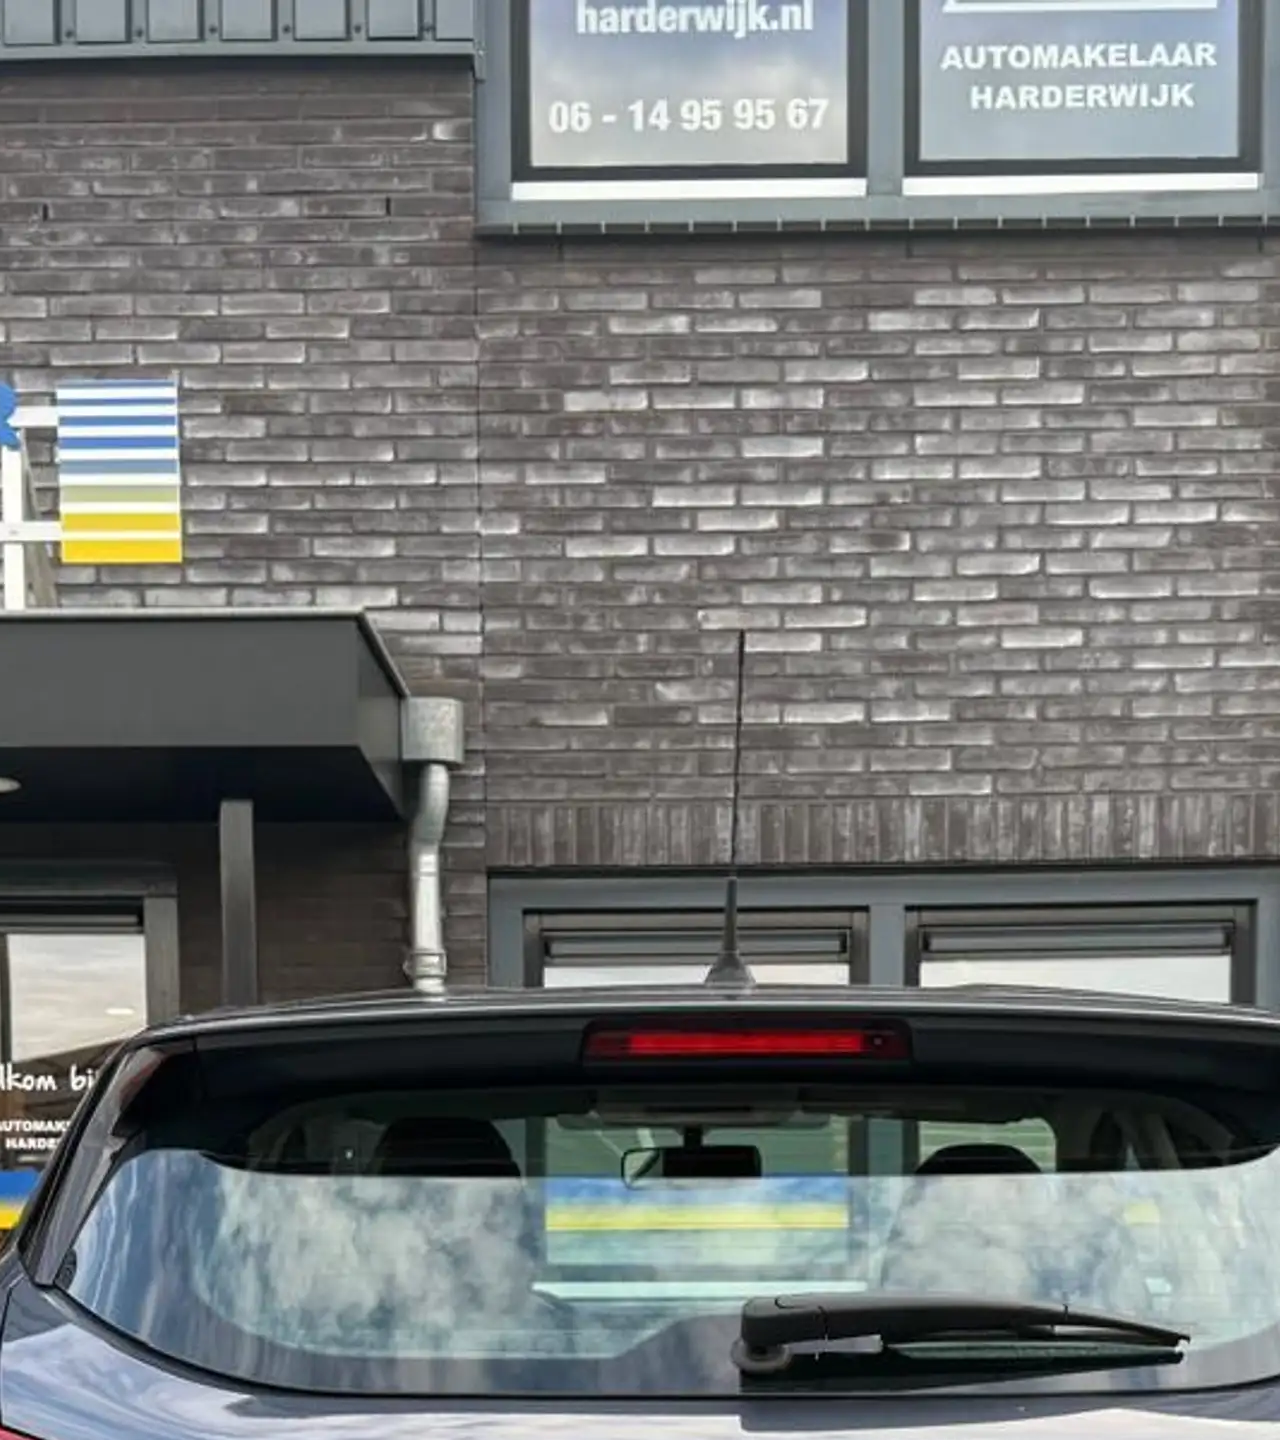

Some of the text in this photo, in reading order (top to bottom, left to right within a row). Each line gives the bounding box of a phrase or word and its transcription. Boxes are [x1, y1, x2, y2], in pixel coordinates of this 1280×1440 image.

[577, 0, 814, 39] harderwijk.nl
[940, 43, 1218, 70] AUTOMAKELAAR
[970, 83, 1196, 109] HARDERWIJK
[548, 98, 829, 132] 06 - 14 95 95 67
[70, 1063, 101, 1091] bi
[6, 1138, 62, 1149] HARDE
